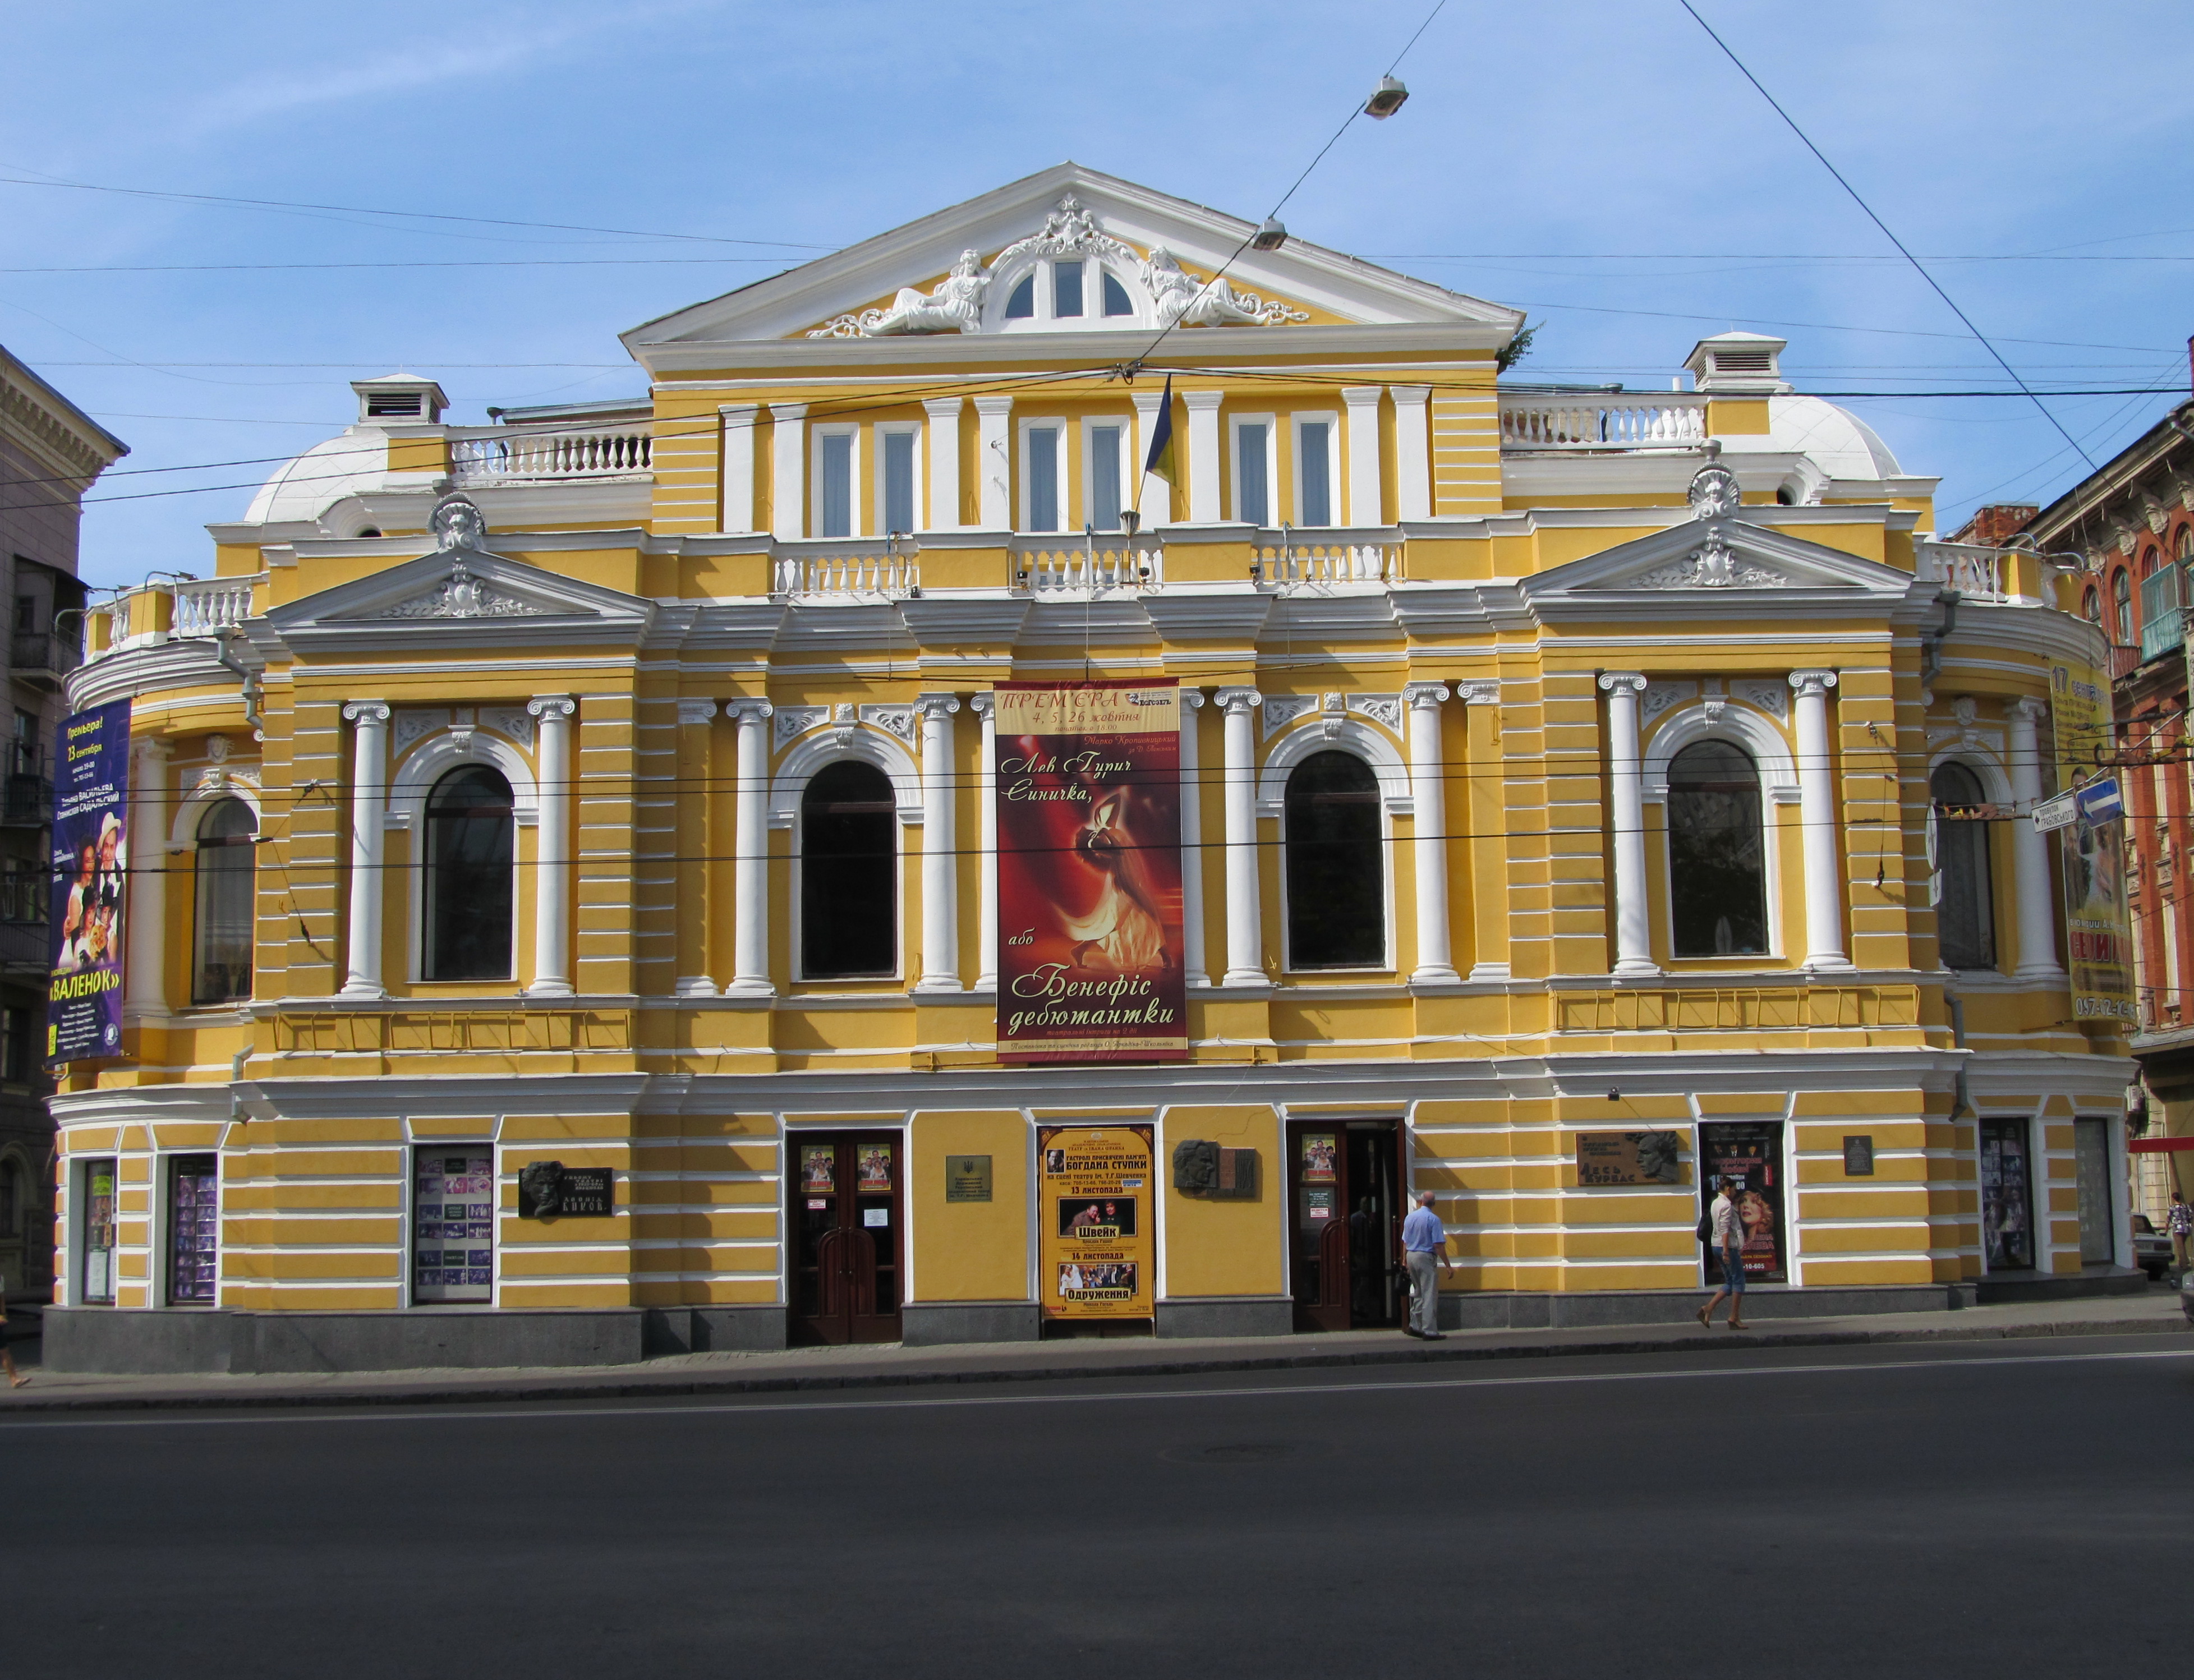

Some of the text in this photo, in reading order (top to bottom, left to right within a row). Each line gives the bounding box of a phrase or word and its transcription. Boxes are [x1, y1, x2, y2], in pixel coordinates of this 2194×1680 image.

[2052, 665, 2068, 693] 17
[1033, 710, 1140, 724] 4, 5, 26 жовтня
[1084, 735, 1113, 745] Марко
[76, 743, 103, 758] сентября
[1000, 752, 1057, 774] Лев
[79, 783, 114, 802] ВАСИЛЬЕВА
[1001, 778, 1093, 804] Синичка,
[80, 791, 119, 812] САДАЛЬСКИЙ
[2041, 809, 2074, 828] ГРАБОВСЬКОГО
[1008, 927, 1035, 946] або
[49, 969, 119, 1001] «ВАЛЕНОК»
[1011, 962, 1152, 1006] Бенефіс
[1008, 995, 1174, 1036] дебютантки
[1066, 1161, 1147, 1171] БОГДАНА СТУПКИ
[1079, 1227, 1116, 1237] Швейк
[1068, 1290, 1129, 1300] Одруження
